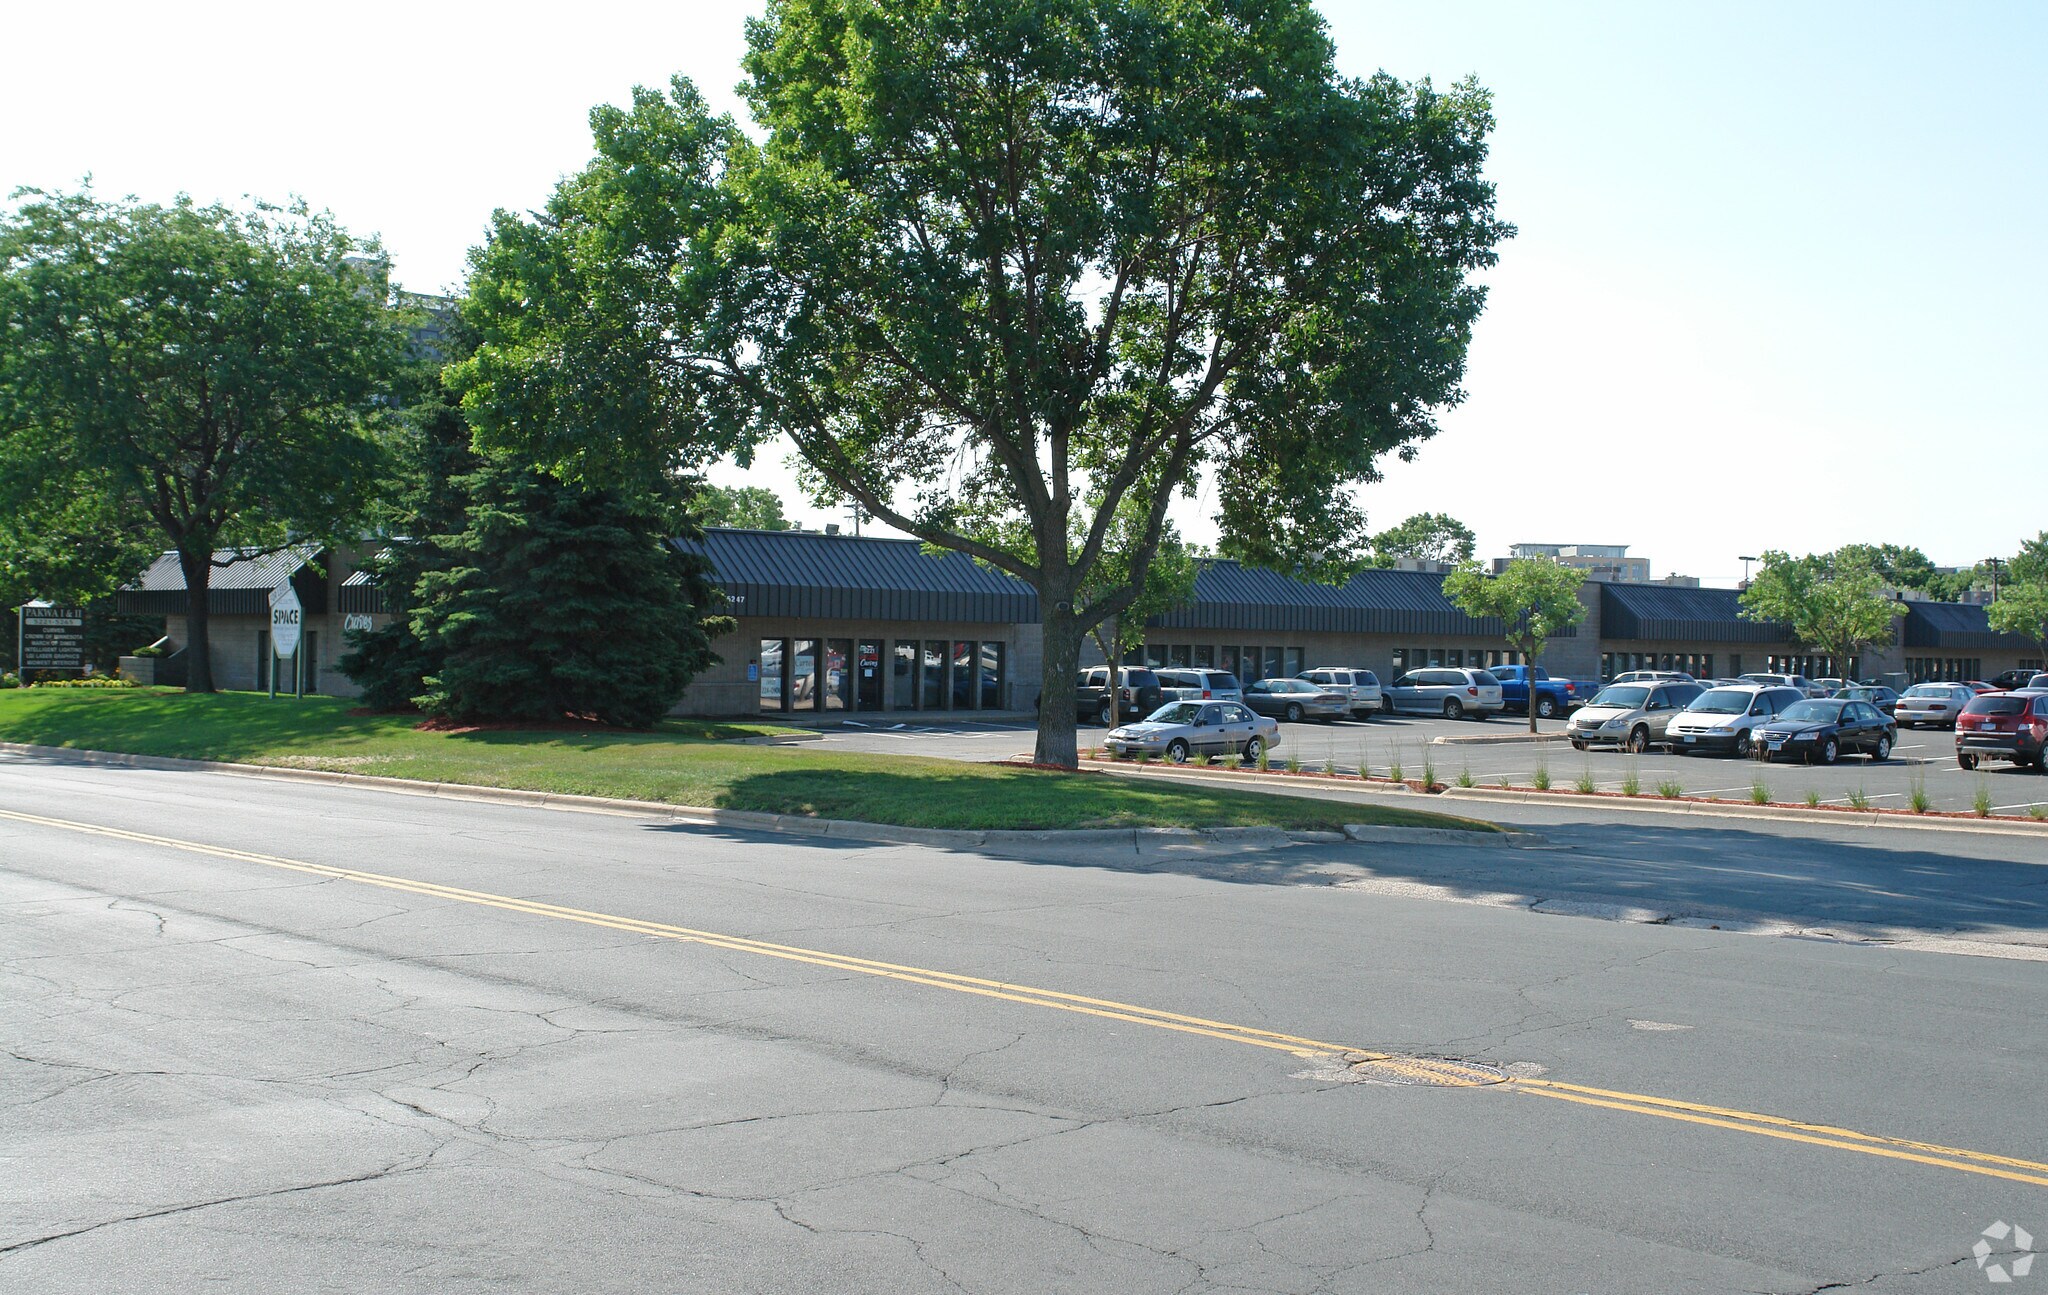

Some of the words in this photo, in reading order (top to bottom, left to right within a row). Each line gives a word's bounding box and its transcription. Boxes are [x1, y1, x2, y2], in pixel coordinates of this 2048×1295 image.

[726, 595, 745, 603] 5247
[25, 608, 59, 617] PAKWA
[65, 609, 73, 617] &
[273, 609, 299, 625] SPACE
[344, 613, 373, 633] Curves
